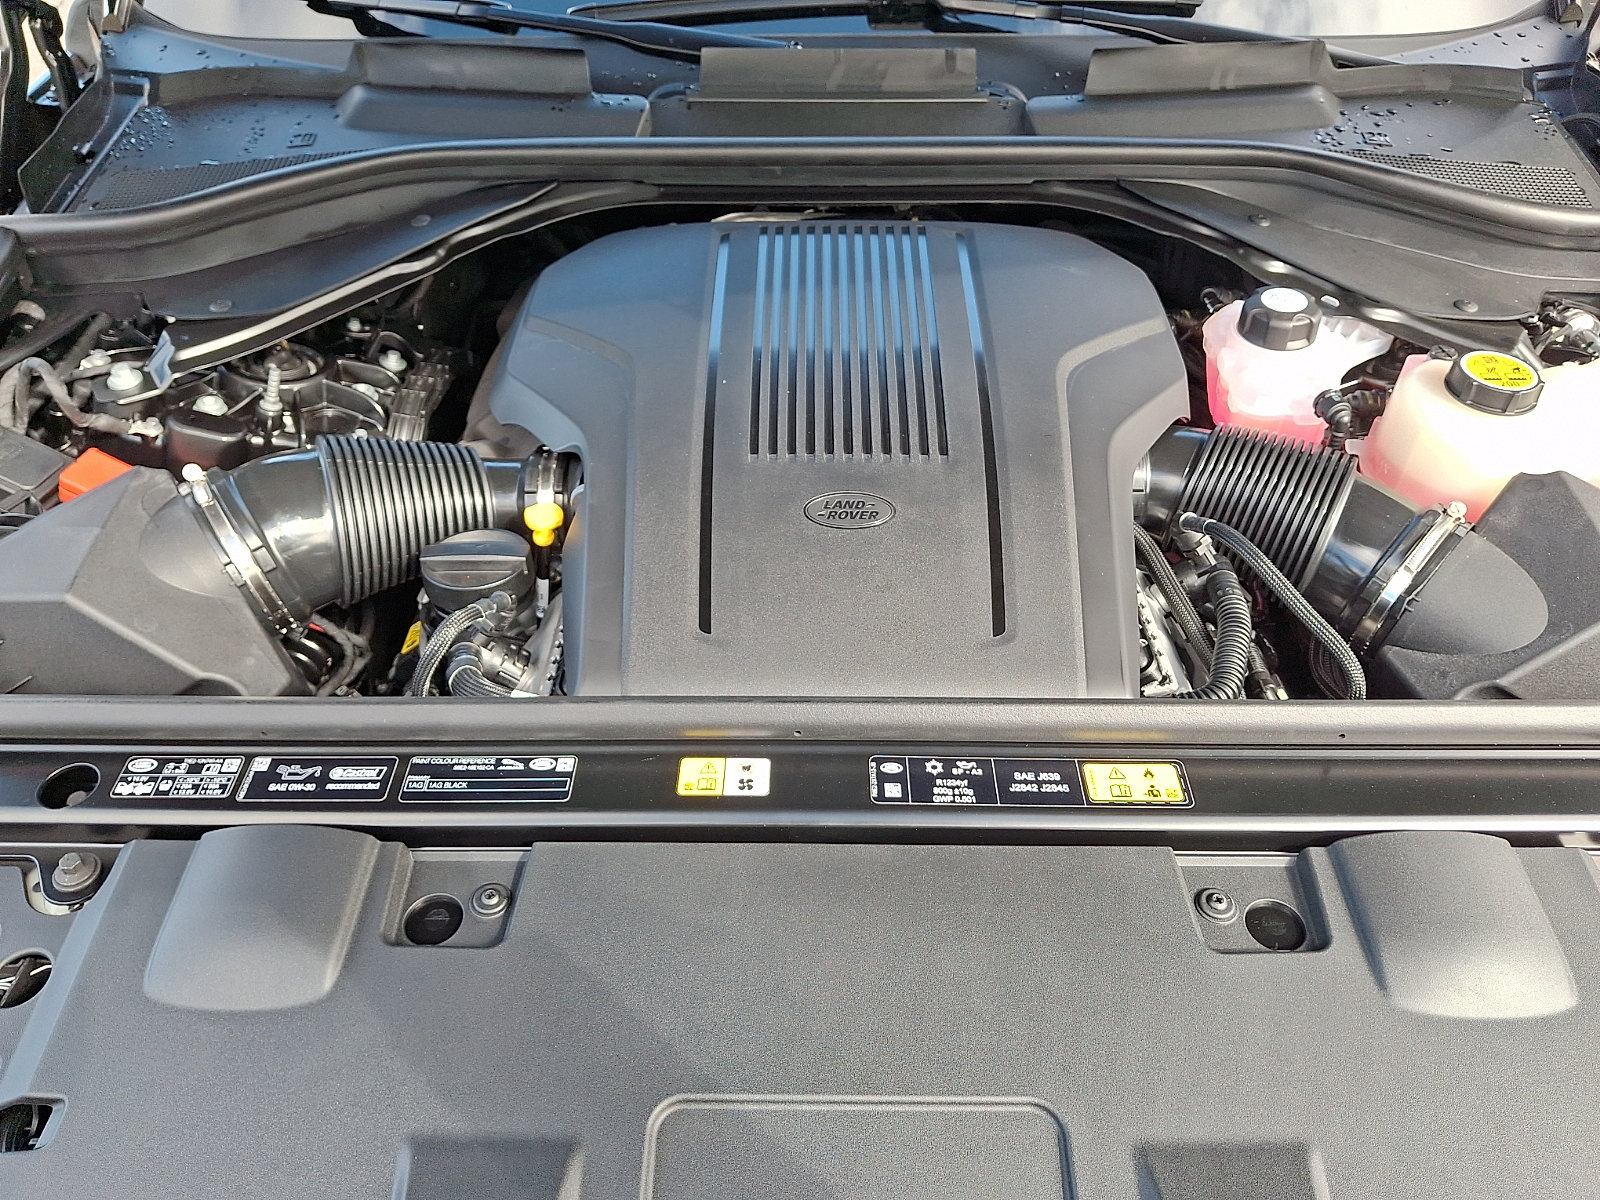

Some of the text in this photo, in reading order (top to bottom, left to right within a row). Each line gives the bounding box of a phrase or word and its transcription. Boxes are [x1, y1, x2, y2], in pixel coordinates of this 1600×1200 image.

[823, 500, 866, 510] LAND
[826, 510, 879, 520] ROVER
[343, 768, 380, 777] Castrol
[1014, 772, 1061, 781] SAE J639
[268, 783, 317, 791] SAE 0W-30
[325, 782, 380, 790] recommended
[935, 778, 968, 788] R1234yf
[1009, 783, 1039, 791] J2842
[932, 795, 954, 803] GWP
